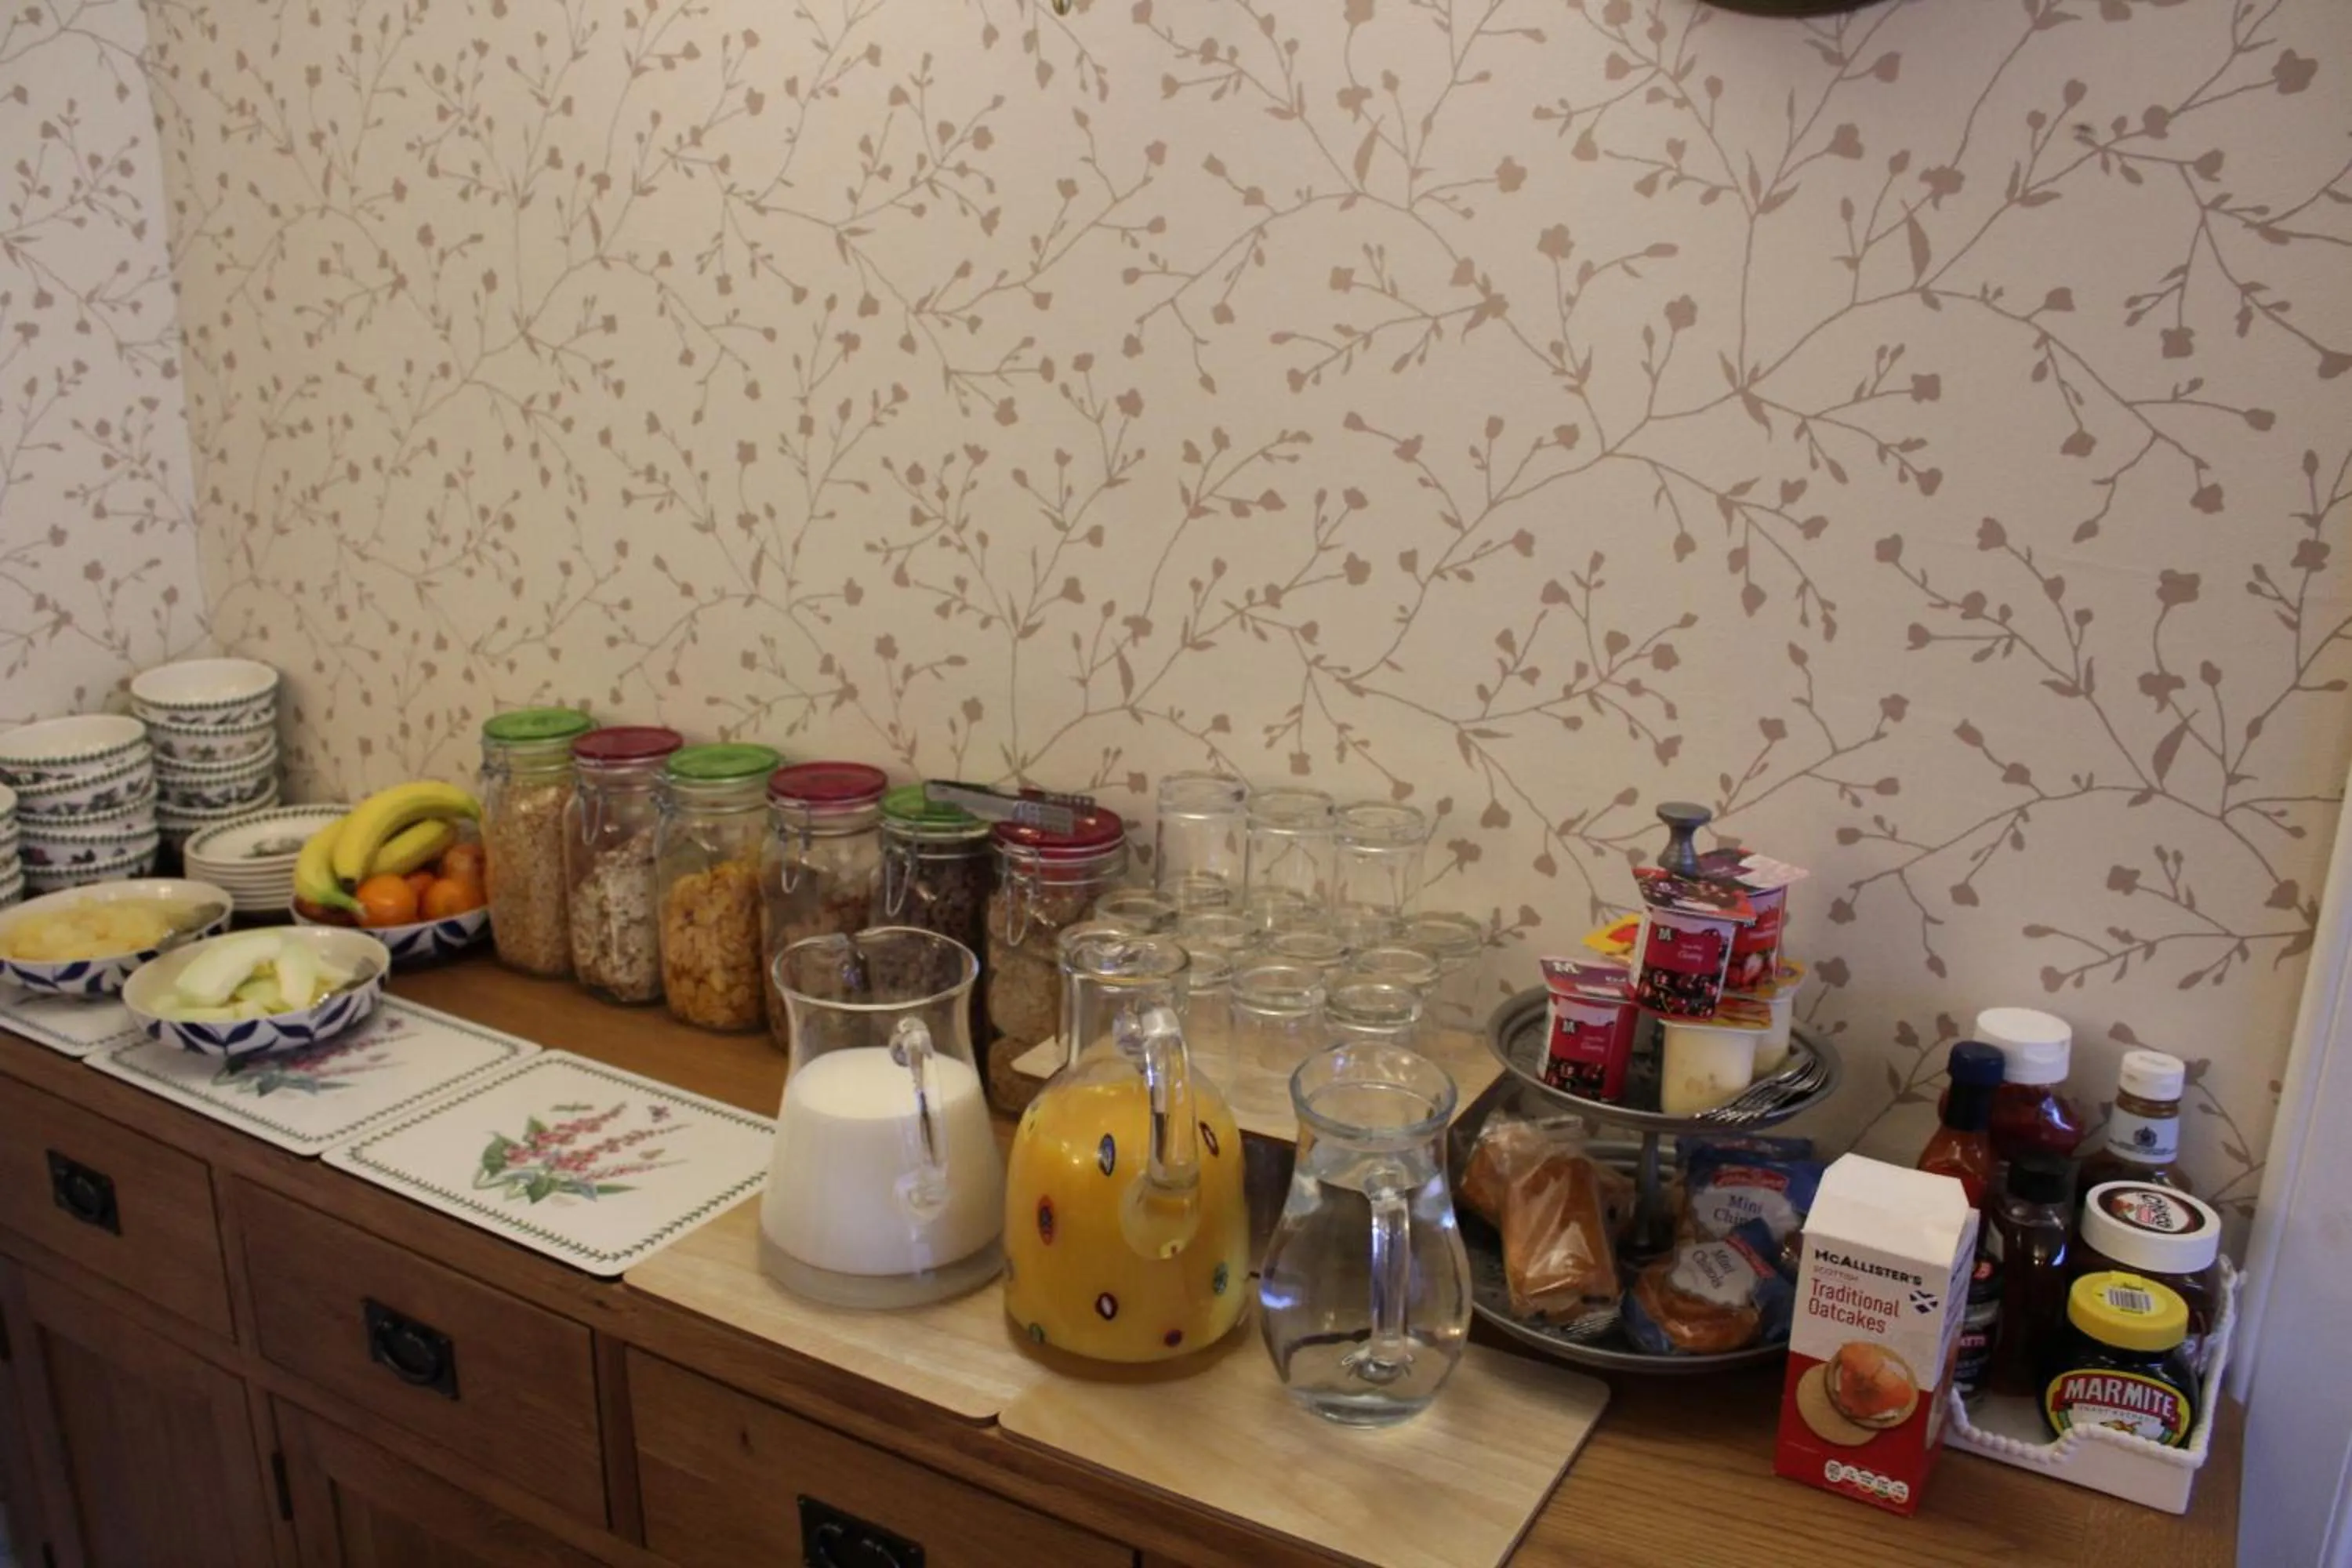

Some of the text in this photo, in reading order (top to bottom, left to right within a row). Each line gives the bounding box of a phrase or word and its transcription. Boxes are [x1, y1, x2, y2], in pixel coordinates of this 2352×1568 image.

[1728, 1193, 1764, 1214] Mini
[1808, 1297, 1887, 1334] Oatcakes
[1811, 1276, 1900, 1319] Traditional
[2063, 1377, 2174, 1418] MARMITE
